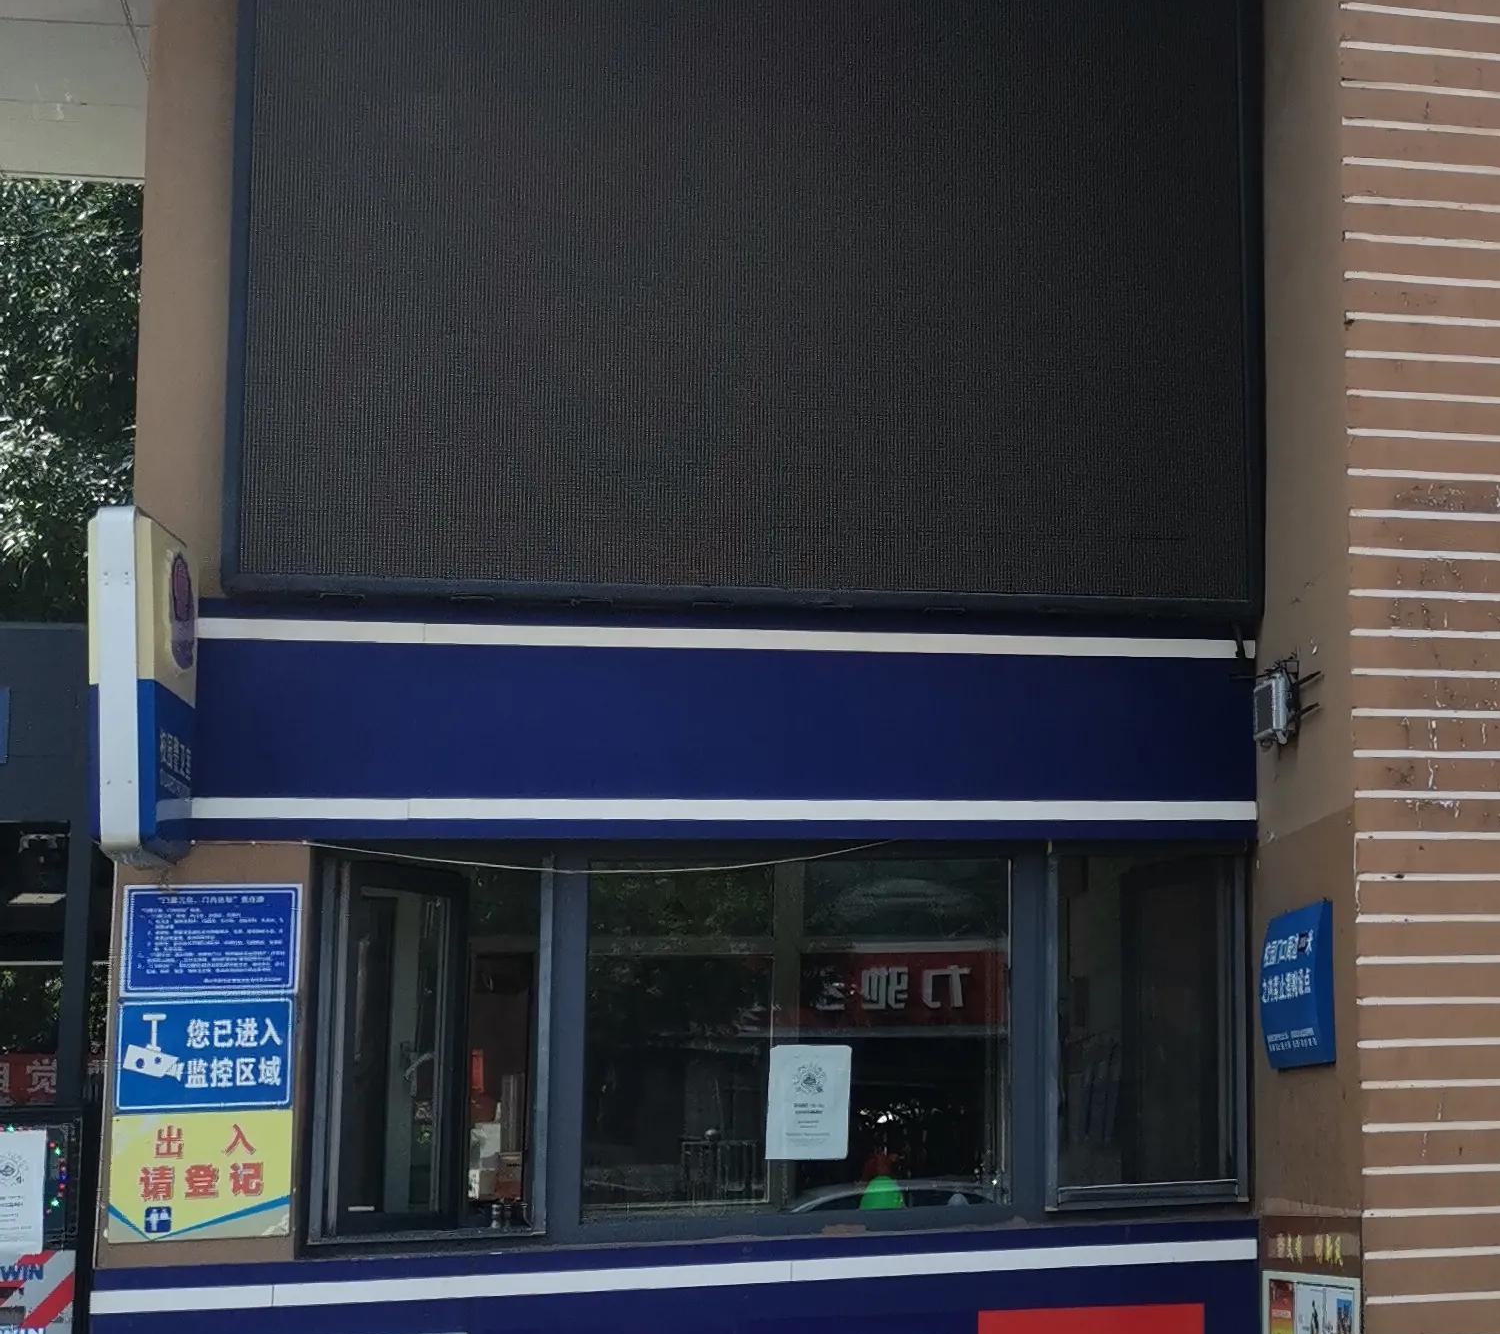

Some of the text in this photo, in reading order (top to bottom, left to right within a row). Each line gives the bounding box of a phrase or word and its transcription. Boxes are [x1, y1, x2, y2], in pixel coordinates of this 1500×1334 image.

[186, 1018, 284, 1048] 您已进入
[184, 1056, 282, 1088] 监控区域
[139, 1162, 264, 1202] 请登记
